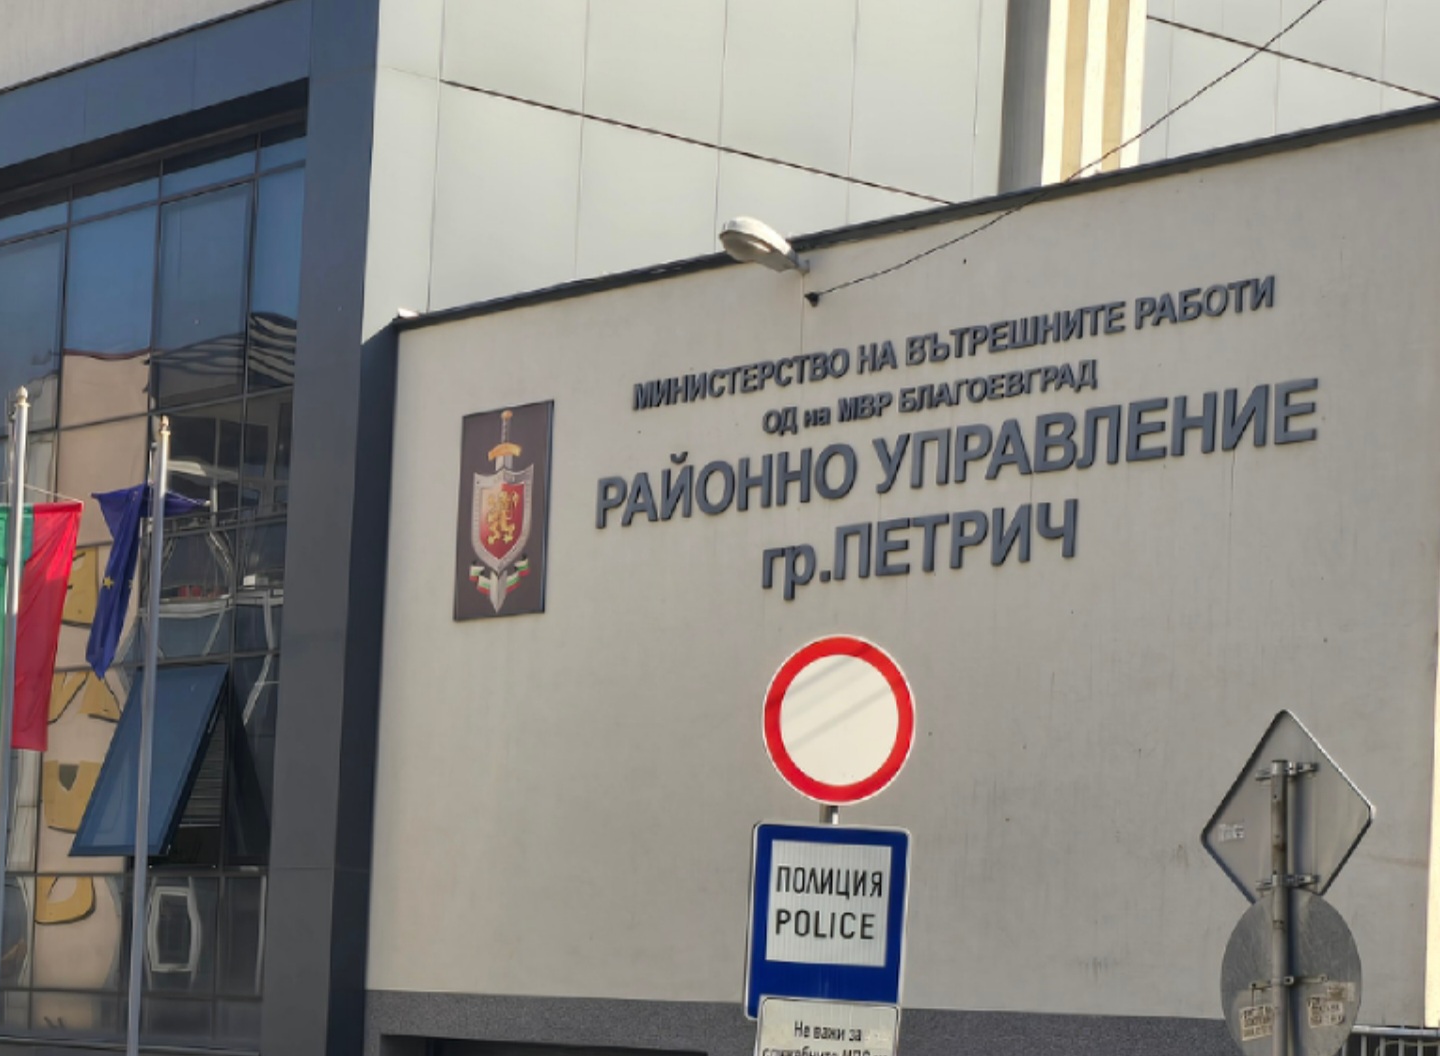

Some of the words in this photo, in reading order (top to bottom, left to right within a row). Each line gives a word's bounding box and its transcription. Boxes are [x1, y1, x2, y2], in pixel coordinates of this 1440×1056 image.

[632, 348, 850, 411] МИНИСТЕРСТВО
[857, 340, 897, 374] НА
[905, 300, 1126, 366] ВЪТРЕШНИТЕ
[1134, 275, 1276, 330] РАБОТИ
[762, 406, 798, 436] ОД
[803, 406, 831, 428] на
[838, 391, 893, 422] МВР
[898, 359, 1098, 413] БЛАГОЕВГРАД
[595, 442, 858, 530] РАЙОННО
[871, 378, 1319, 494] УПРАВЛЕНИЕ
[775, 865, 884, 900] ПОЛИЦИЯ
[775, 908, 876, 940] POLICE
[794, 1020, 811, 1039] Не
[813, 1026, 845, 1042] важи
[848, 1028, 862, 1042] за
